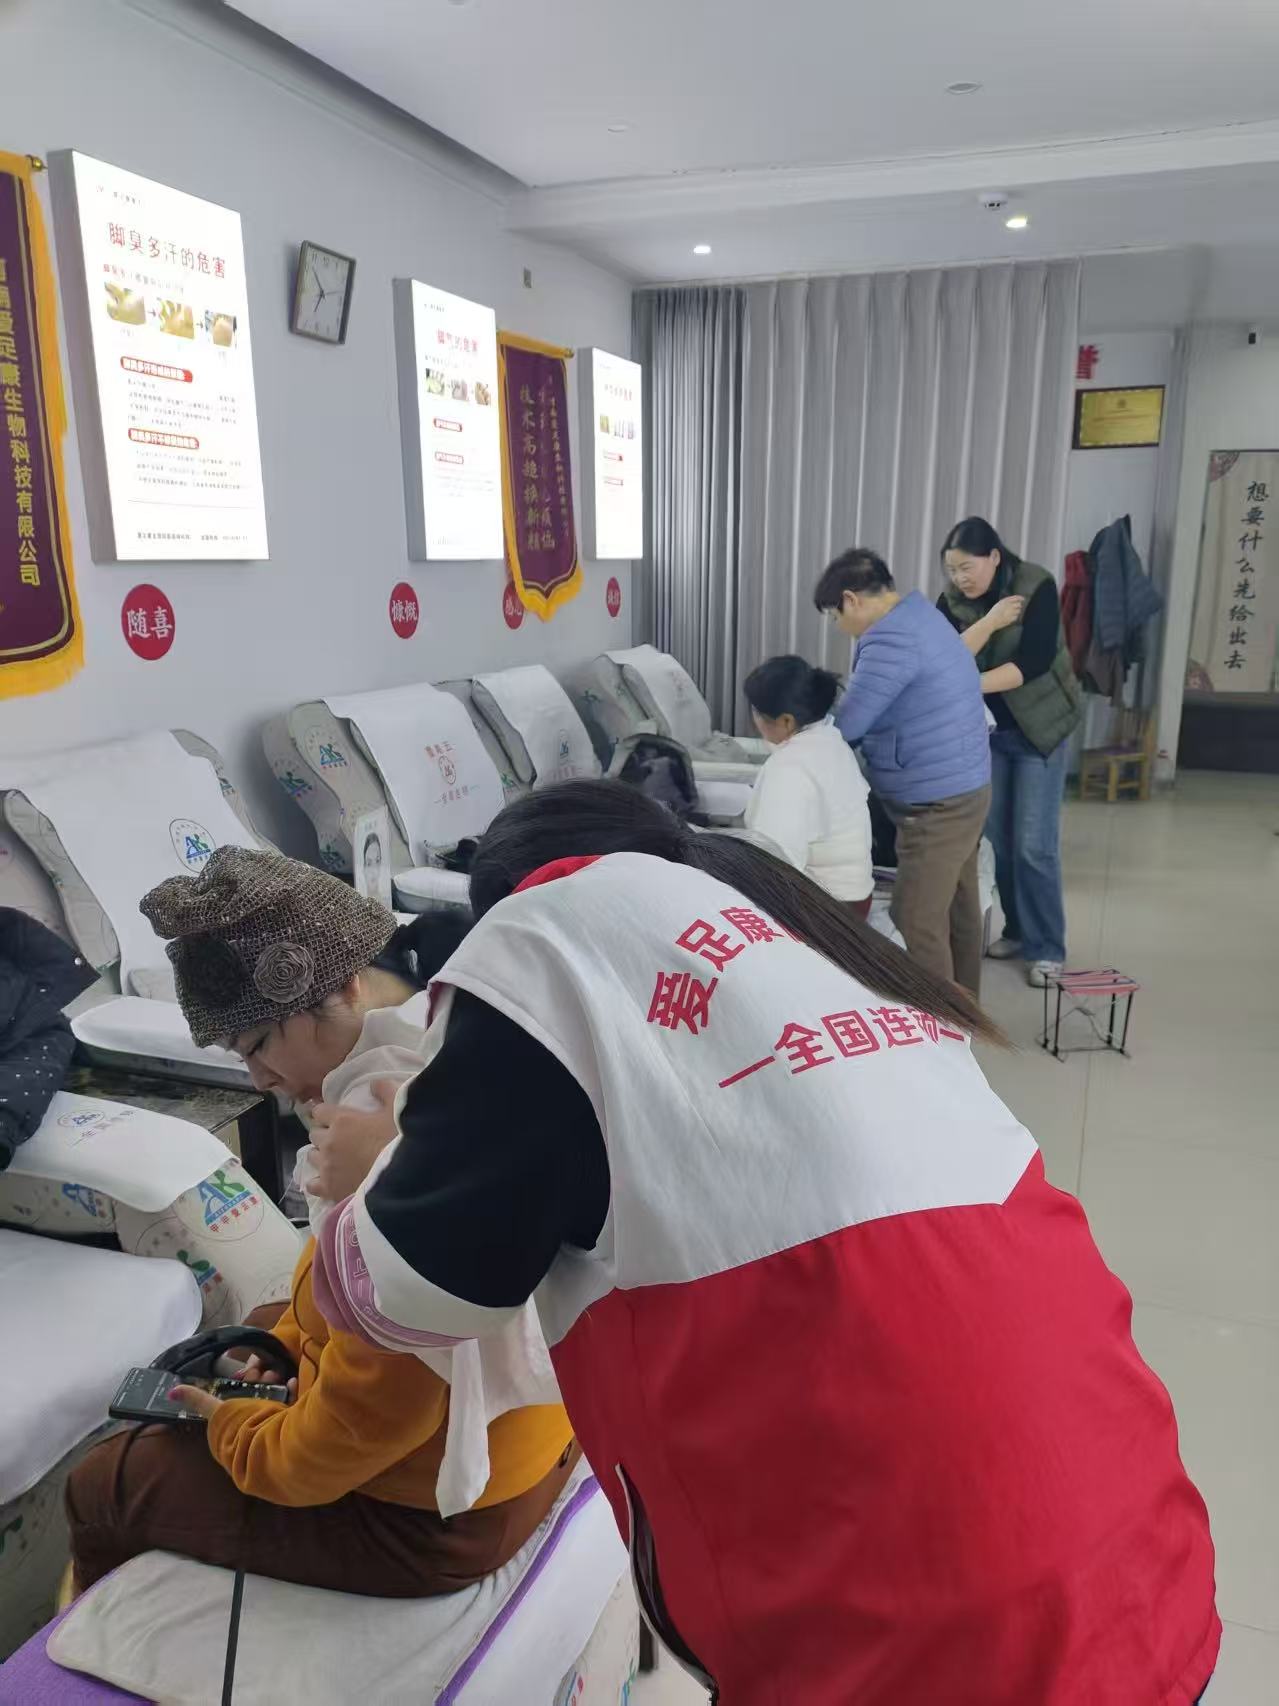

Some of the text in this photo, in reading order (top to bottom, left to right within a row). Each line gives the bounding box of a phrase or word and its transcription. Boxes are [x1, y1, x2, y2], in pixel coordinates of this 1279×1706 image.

[108, 222, 225, 278] 脚臭多汗的危害
[1223, 481, 1269, 670] 想要什么先给出去
[127, 606, 173, 641] 随喜
